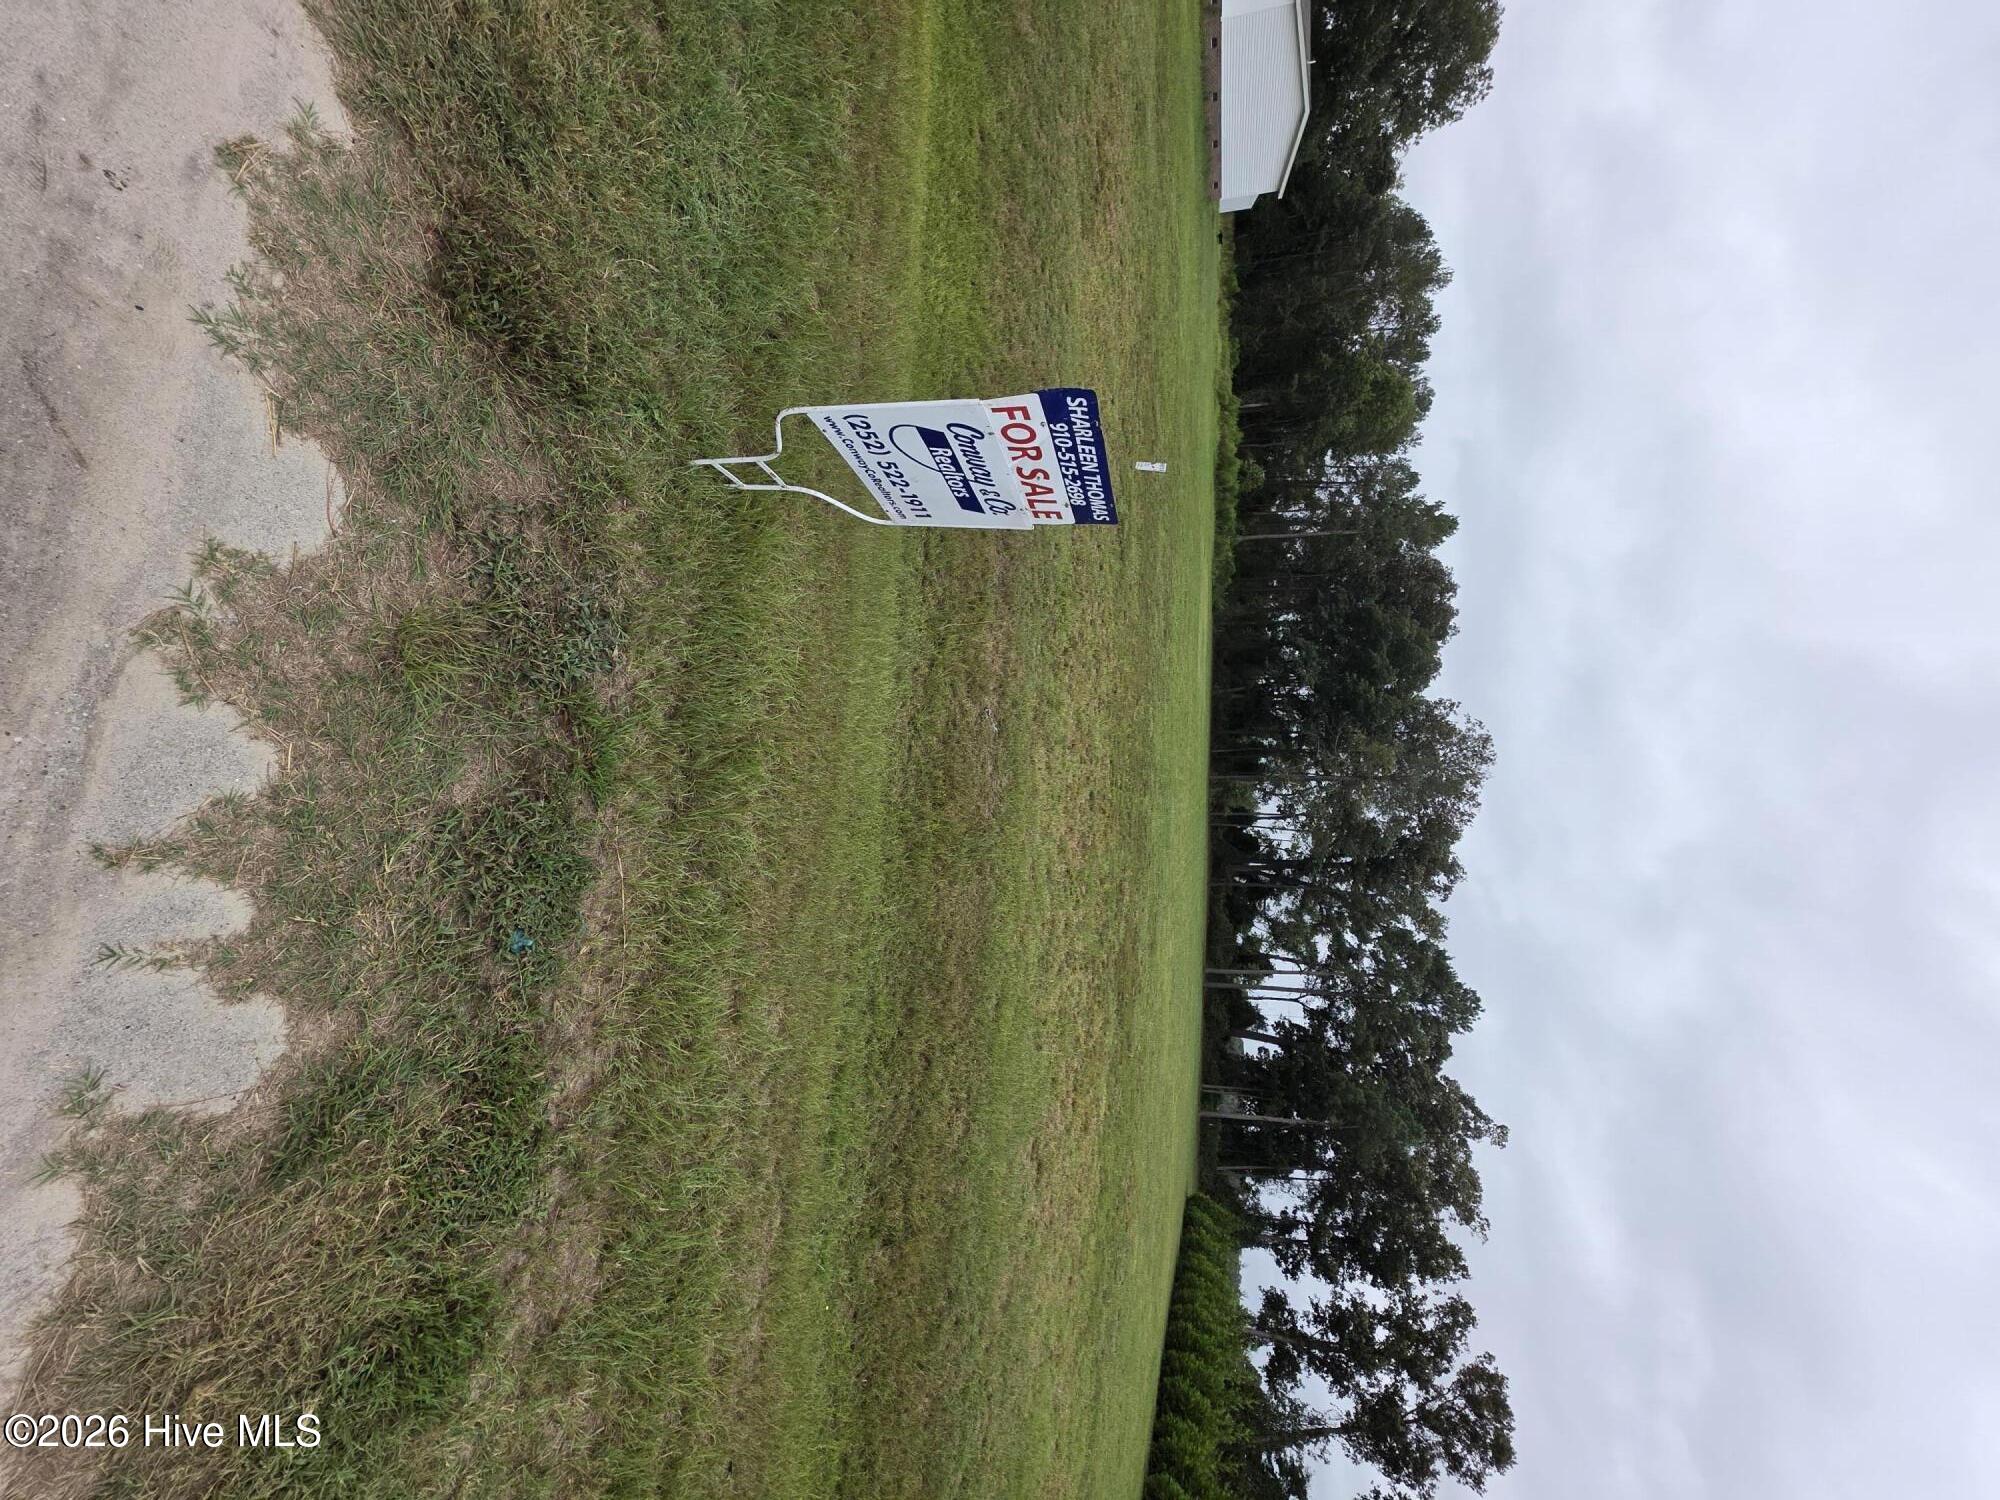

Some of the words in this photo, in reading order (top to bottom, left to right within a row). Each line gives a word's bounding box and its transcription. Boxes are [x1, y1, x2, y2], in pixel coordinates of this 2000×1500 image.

[823, 416, 907, 520] www.ConwayCoRealtors.com
[842, 414, 891, 456] (252)
[877, 460, 932, 519] 522-1911
[929, 447, 970, 498] Realtors
[946, 423, 996, 488] Conway
[984, 497, 1017, 516] Co.
[991, 405, 1043, 462] FOR
[1050, 423, 1087, 506] 910-515-2698
[1066, 396, 1098, 473] SHARLEEN
[1086, 471, 1110, 521] THOMAS
[1015, 466, 1063, 520] SALE
